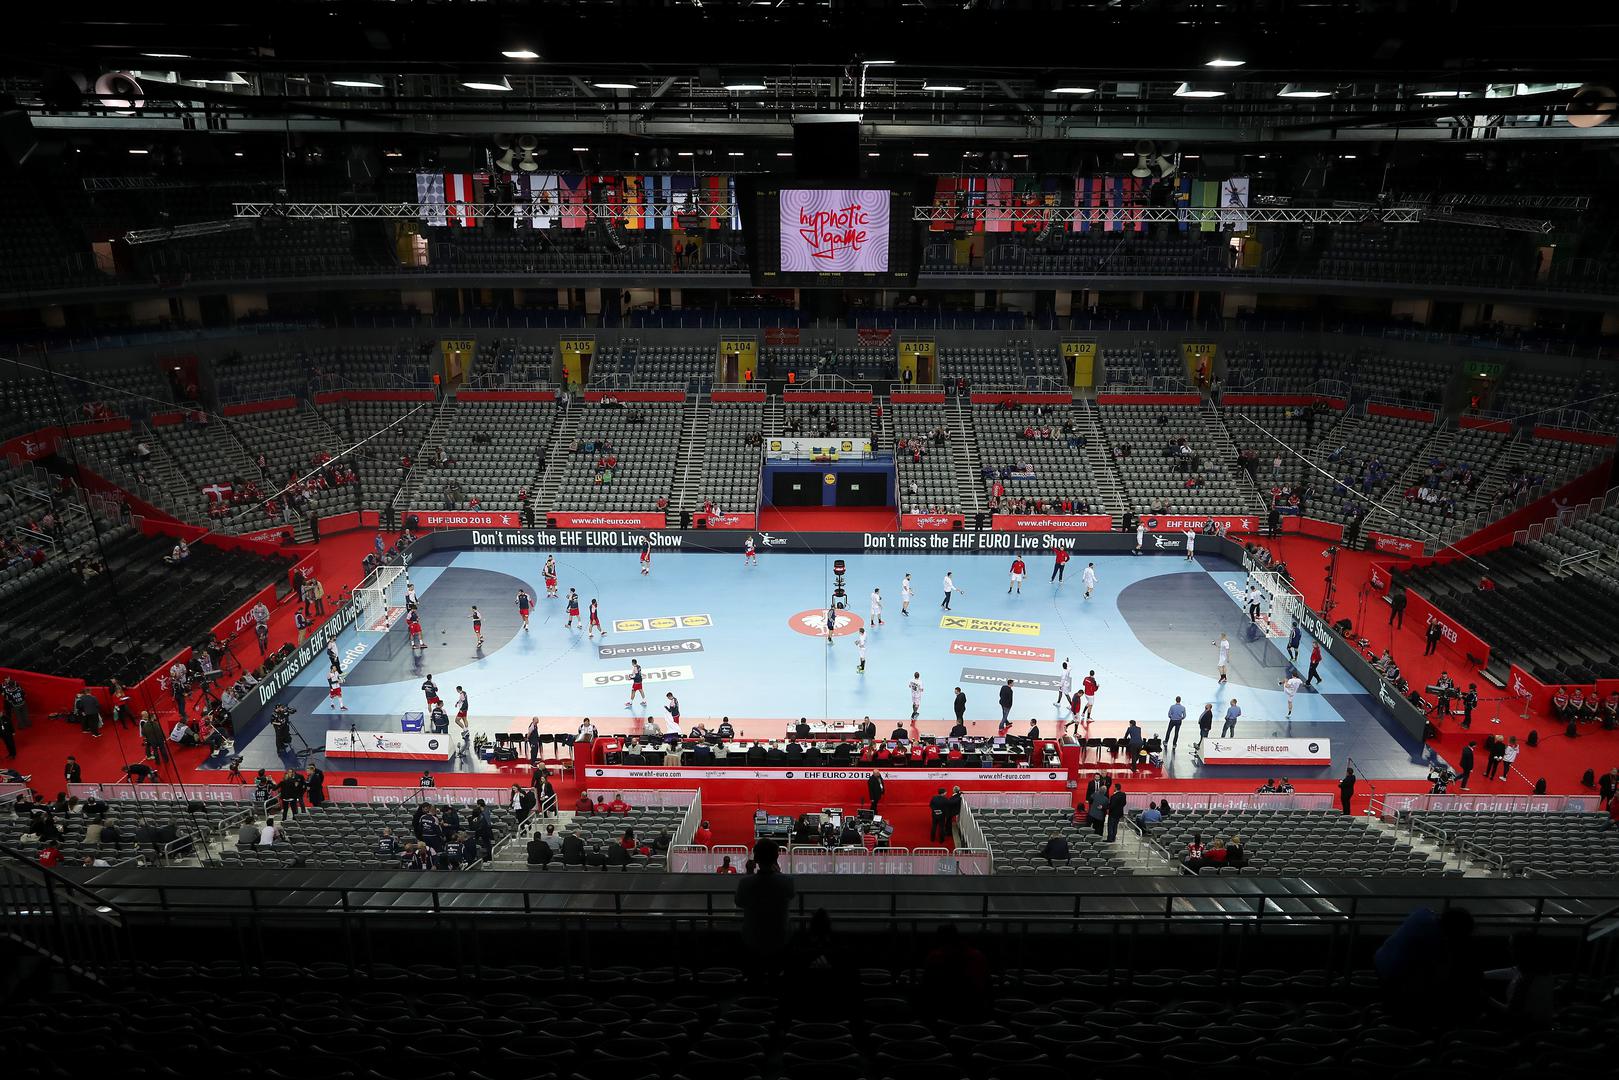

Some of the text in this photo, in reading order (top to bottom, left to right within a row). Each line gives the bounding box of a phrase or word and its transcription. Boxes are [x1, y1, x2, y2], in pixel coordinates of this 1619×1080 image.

[799, 204, 869, 248] hypnotic
[811, 228, 869, 259] game
[447, 342, 472, 350] A 106
[565, 342, 590, 350] A 105
[726, 343, 751, 351] A 104
[904, 343, 930, 352] A 103
[1065, 344, 1091, 353] A 102
[1186, 345, 1211, 353] A 101
[427, 516, 492, 525] EHF EURO 2018
[571, 517, 641, 525] www.ehf-euro.com
[1017, 519, 1087, 528] www.ehf-euro.com
[1166, 520, 1182, 528] EHF
[472, 530, 682, 547] Don't miss the EHF EURO Live Show
[863, 533, 1076, 549] Don't miss the EHF EURO Live Show
[970, 624, 1011, 633] BANK
[971, 619, 1039, 630] Raiffeisen
[1426, 613, 1458, 644] ZREB
[1315, 619, 1334, 650] Show
[600, 643, 680, 656] Gjensidige
[953, 643, 1051, 658] Kurzurlaub.de
[259, 671, 282, 706] Don't
[280, 660, 300, 685] miss
[299, 647, 311, 668] the
[310, 627, 324, 656] EHF
[324, 614, 342, 642] EURO
[340, 642, 369, 671] erflor
[1246, 744, 1289, 752] ehf-euro.com
[629, 770, 682, 778] www.ehf-euro.com
[804, 771, 821, 779] EHF
[822, 771, 847, 779] EURO
[1191, 850, 1201, 858] 33
